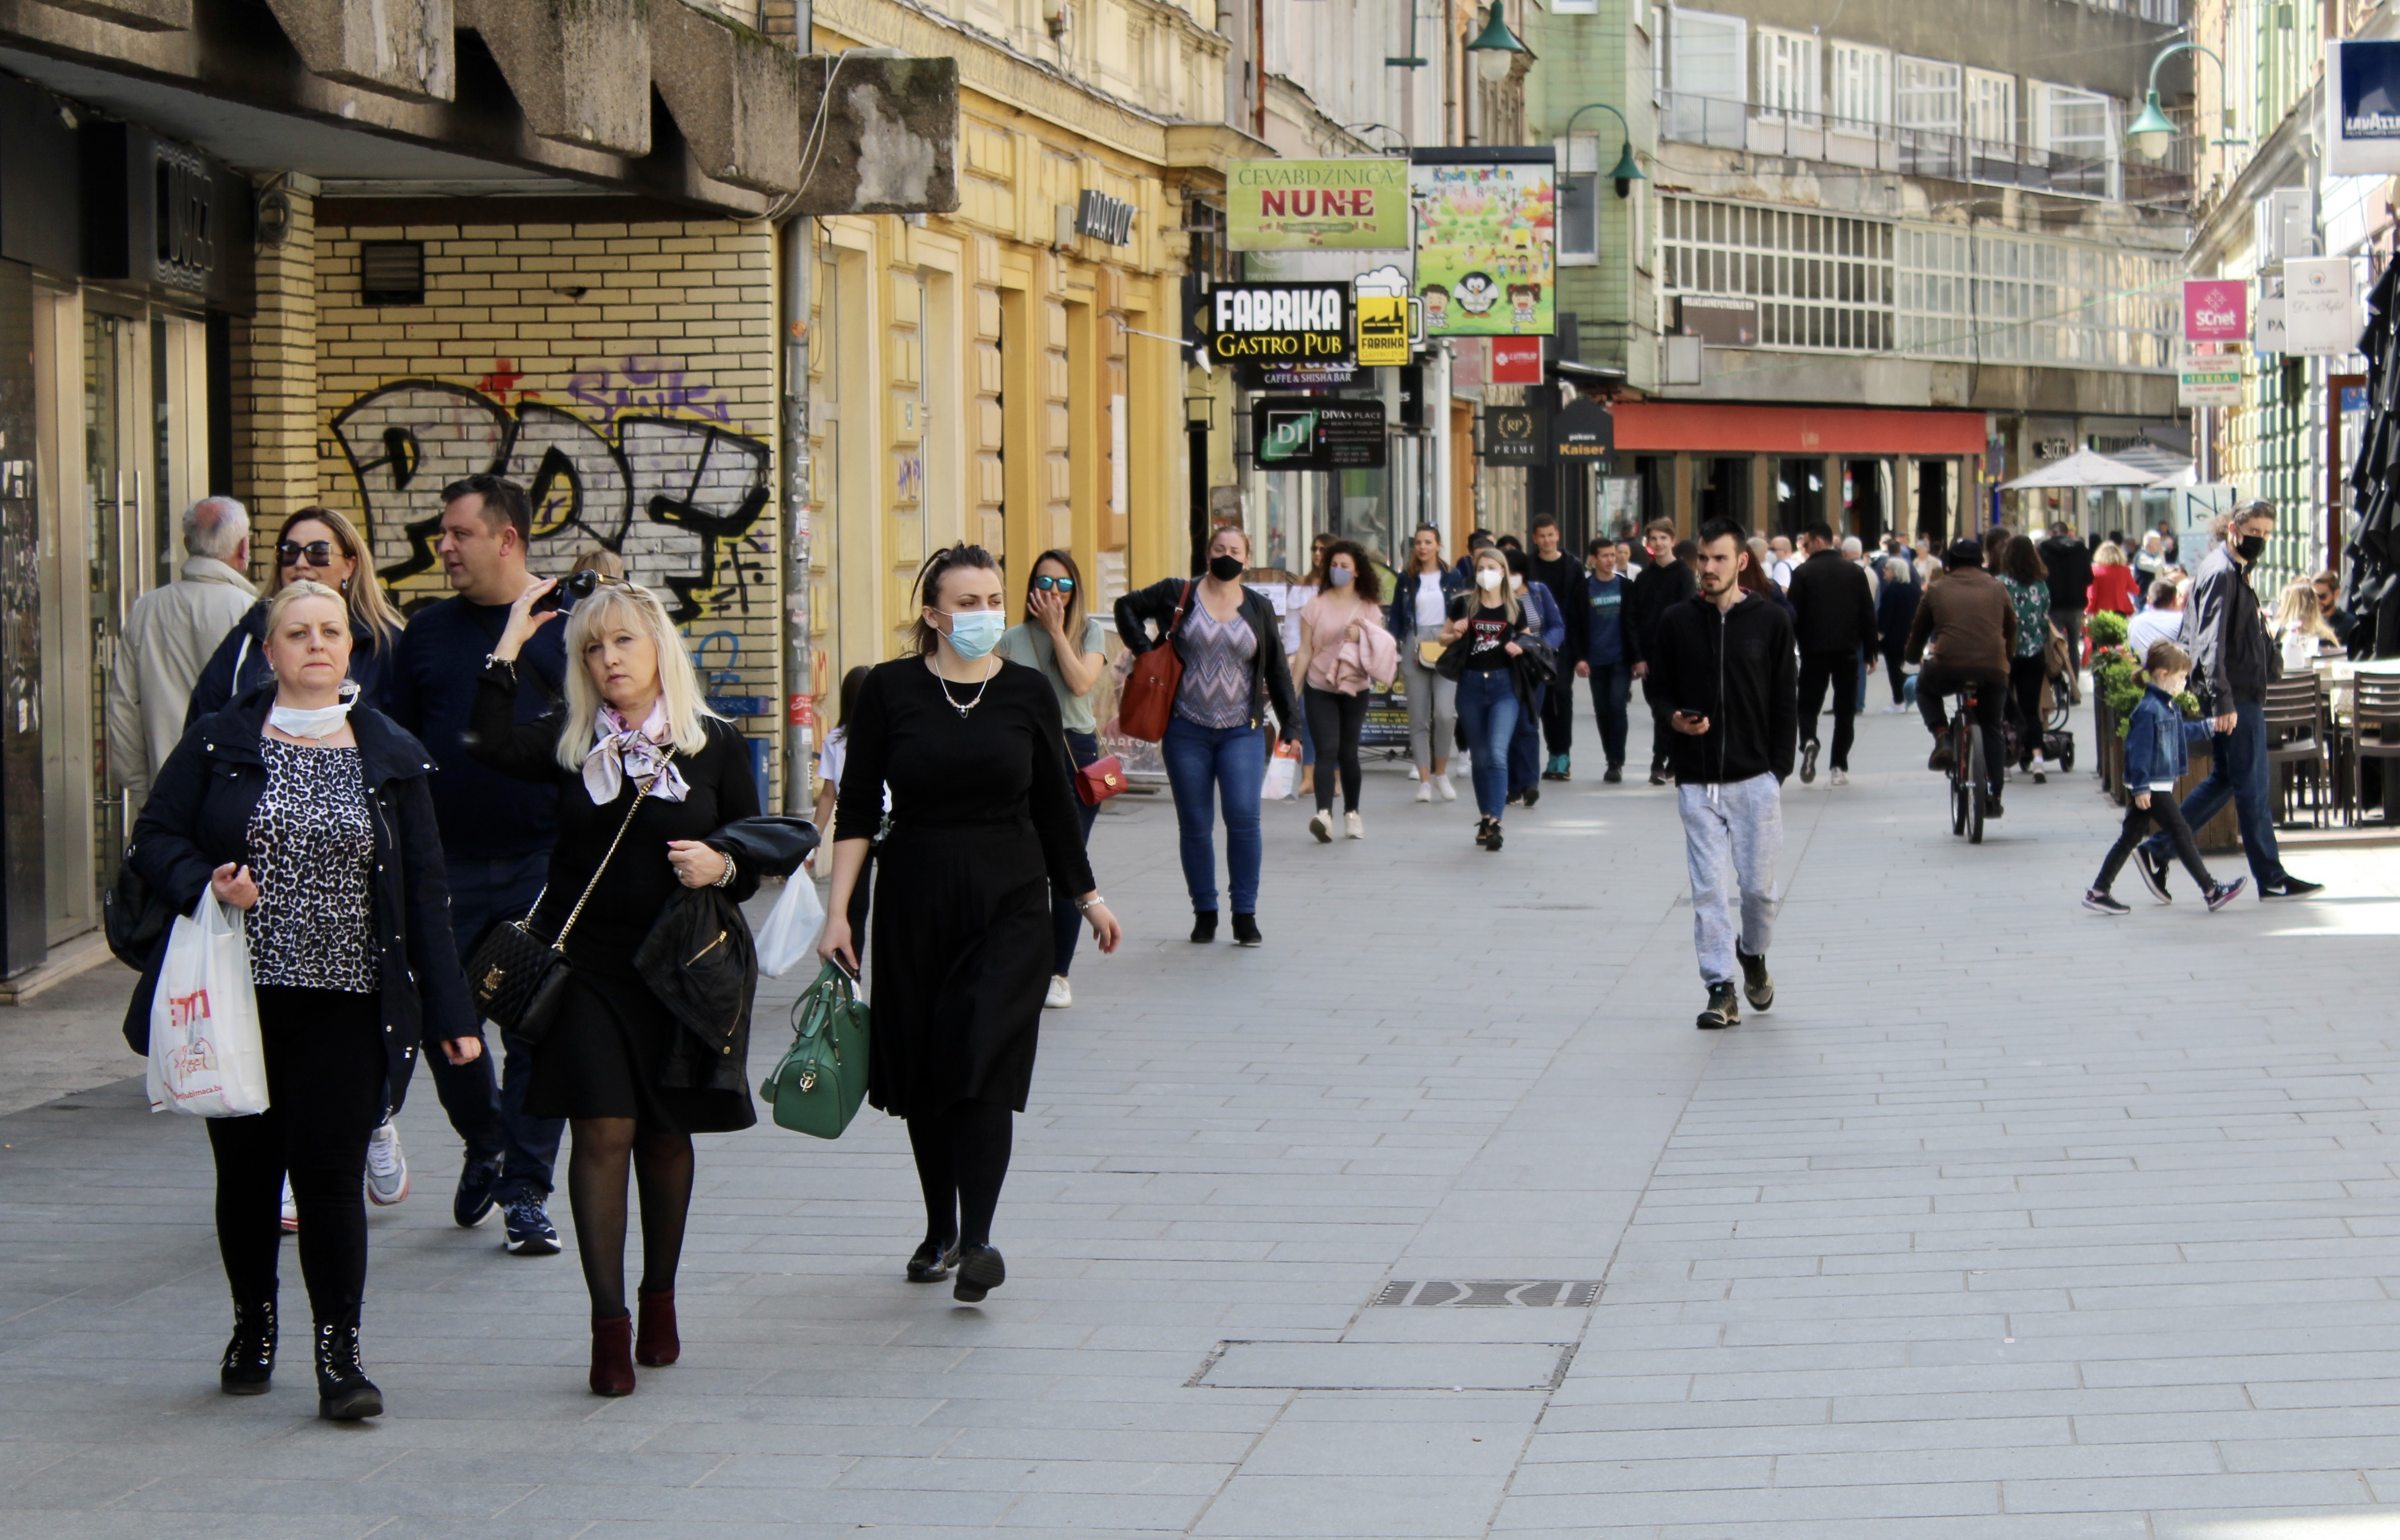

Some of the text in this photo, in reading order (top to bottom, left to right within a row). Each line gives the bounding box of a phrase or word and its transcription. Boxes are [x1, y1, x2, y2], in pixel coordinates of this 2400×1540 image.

[1261, 189, 1374, 217] NUNE
[1216, 289, 1341, 332] FABRIKA
[2196, 309, 2236, 326] SCnet
[1362, 337, 1404, 349] FABRIKA
[1265, 373, 1352, 383] CAFFE & SHISHA BAR
[1507, 419, 1523, 432] RP
[1278, 423, 1303, 444] DI
[1569, 434, 1596, 442] pekara
[1494, 445, 1535, 455] PRIME
[1559, 444, 1605, 455] Kaiser
[1475, 623, 1502, 632] GUESS
